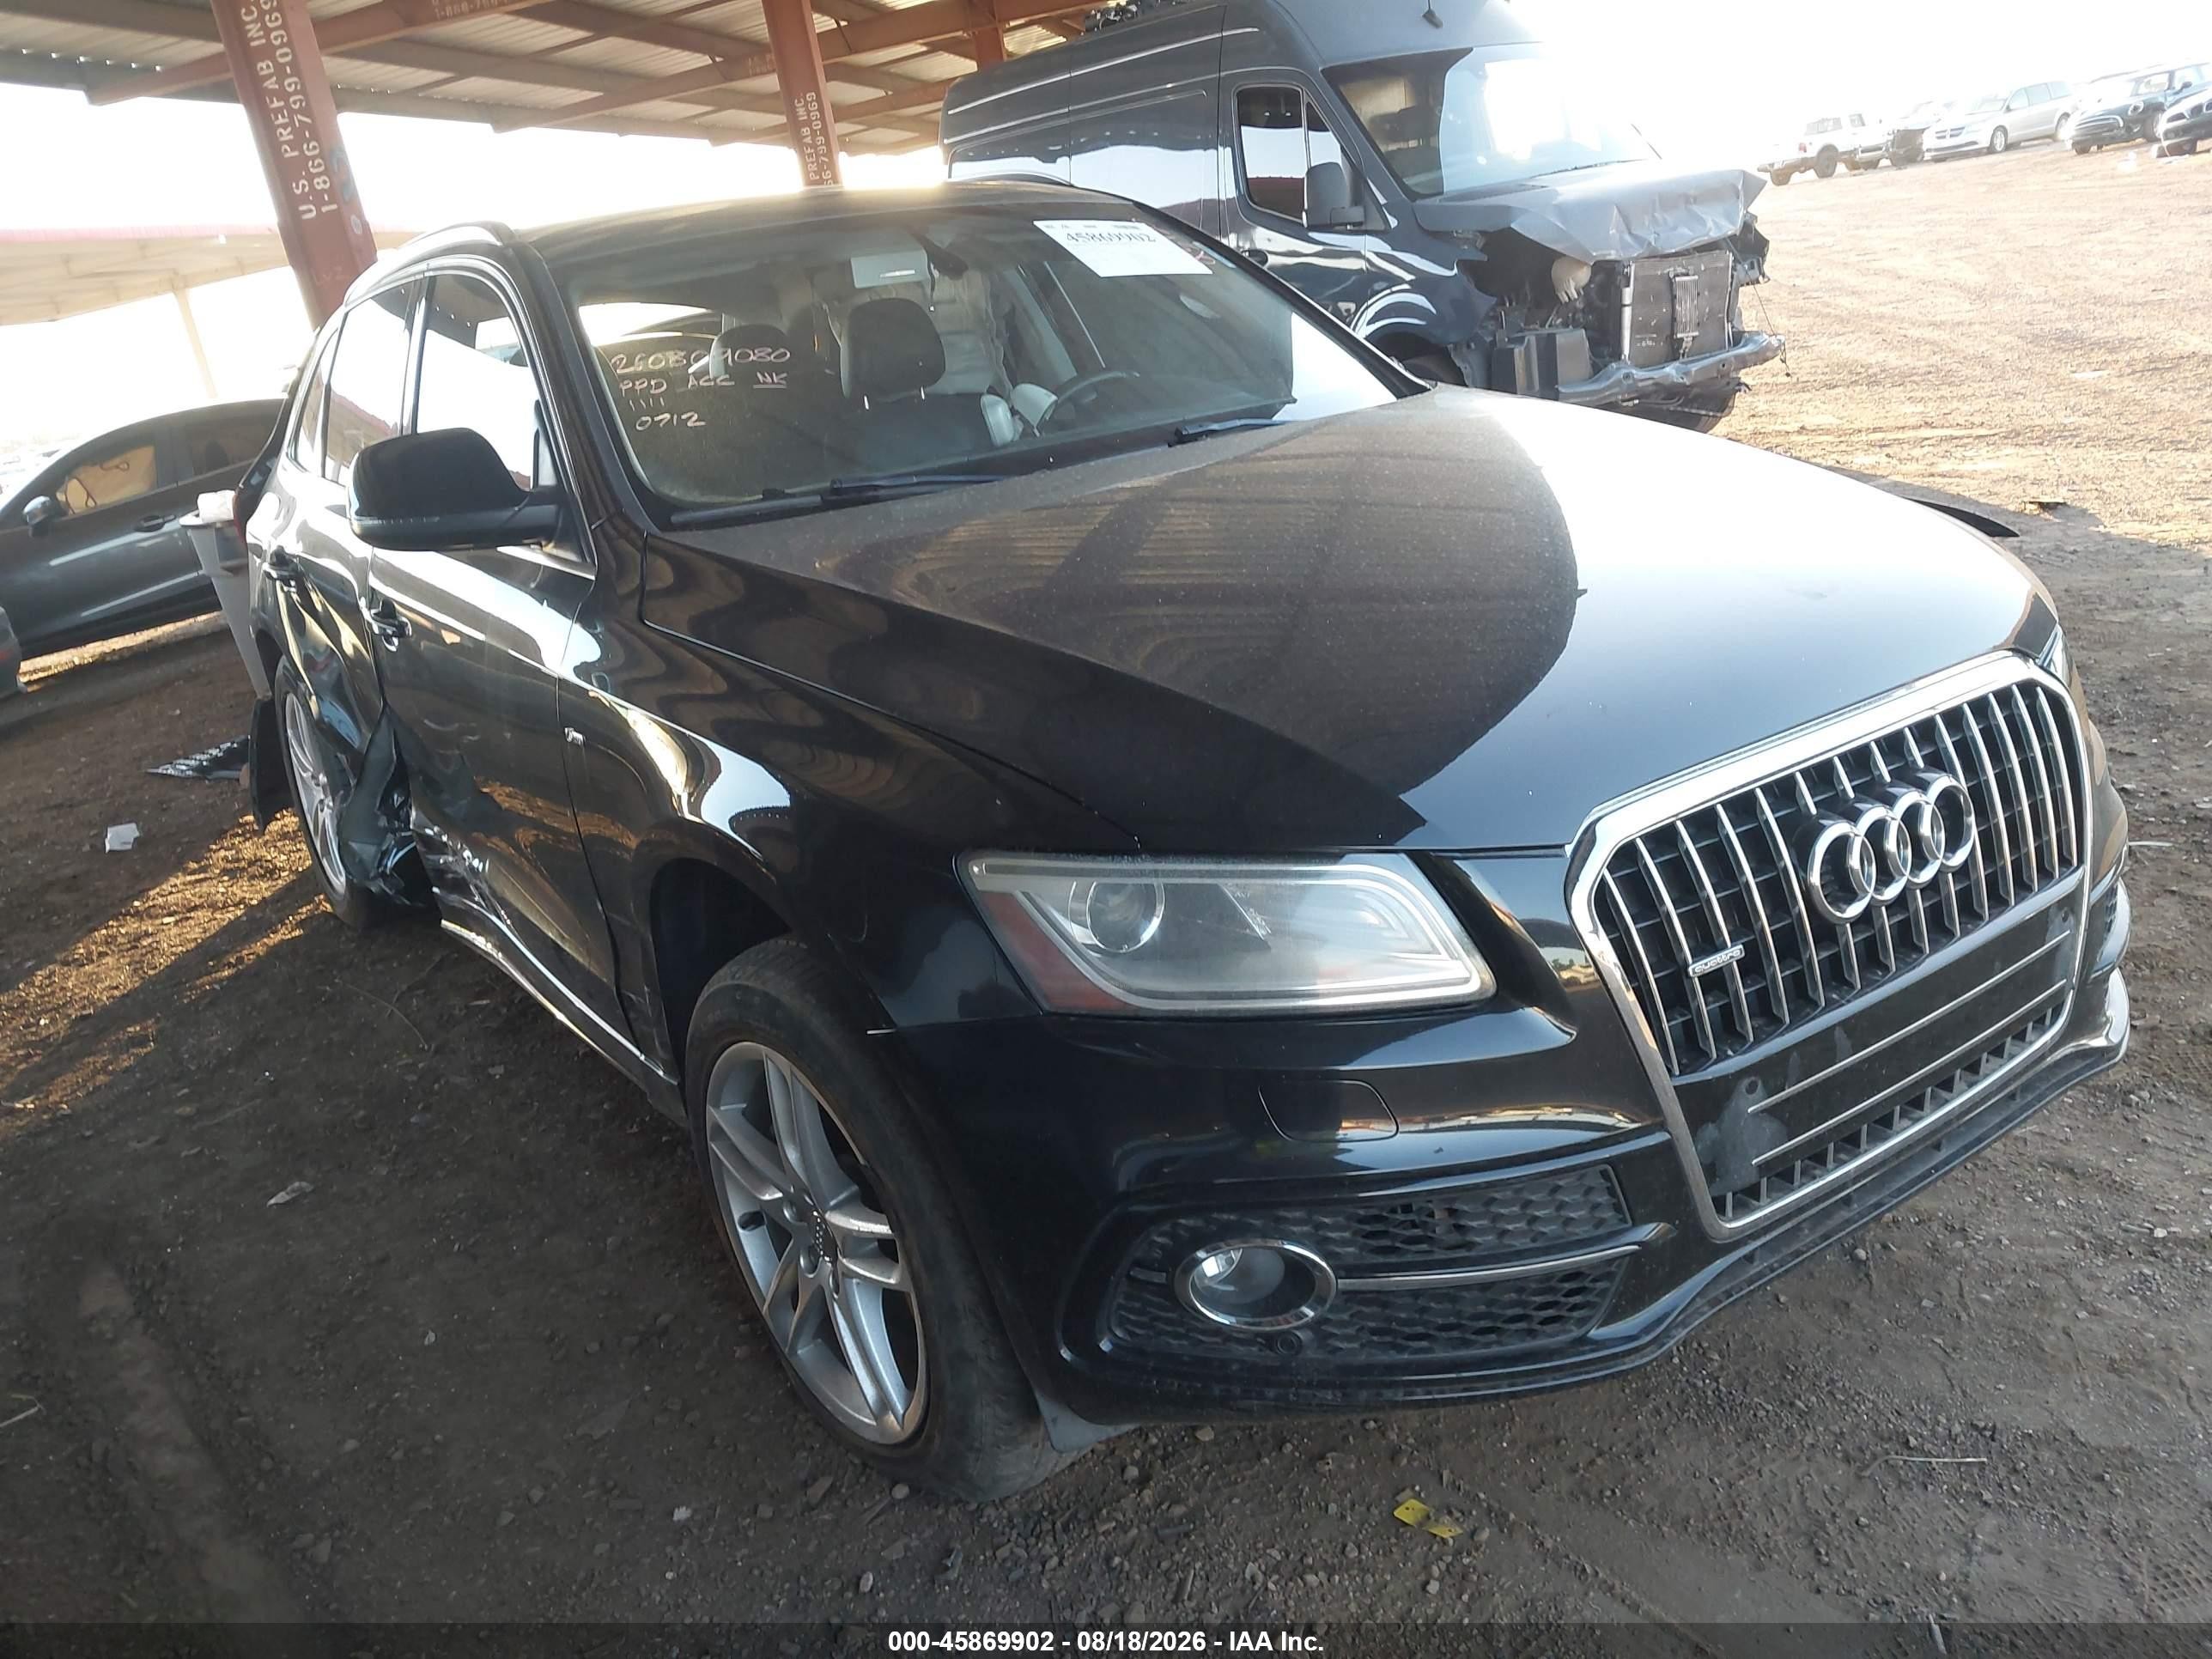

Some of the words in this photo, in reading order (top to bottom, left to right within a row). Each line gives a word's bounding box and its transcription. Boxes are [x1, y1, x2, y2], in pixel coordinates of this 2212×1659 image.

[257, 59, 300, 158] PREFAB
[799, 126, 820, 180] PREFAB
[292, 170, 317, 220] U.S.
[635, 410, 707, 431] 0712
[1693, 948, 1741, 975] quattro
